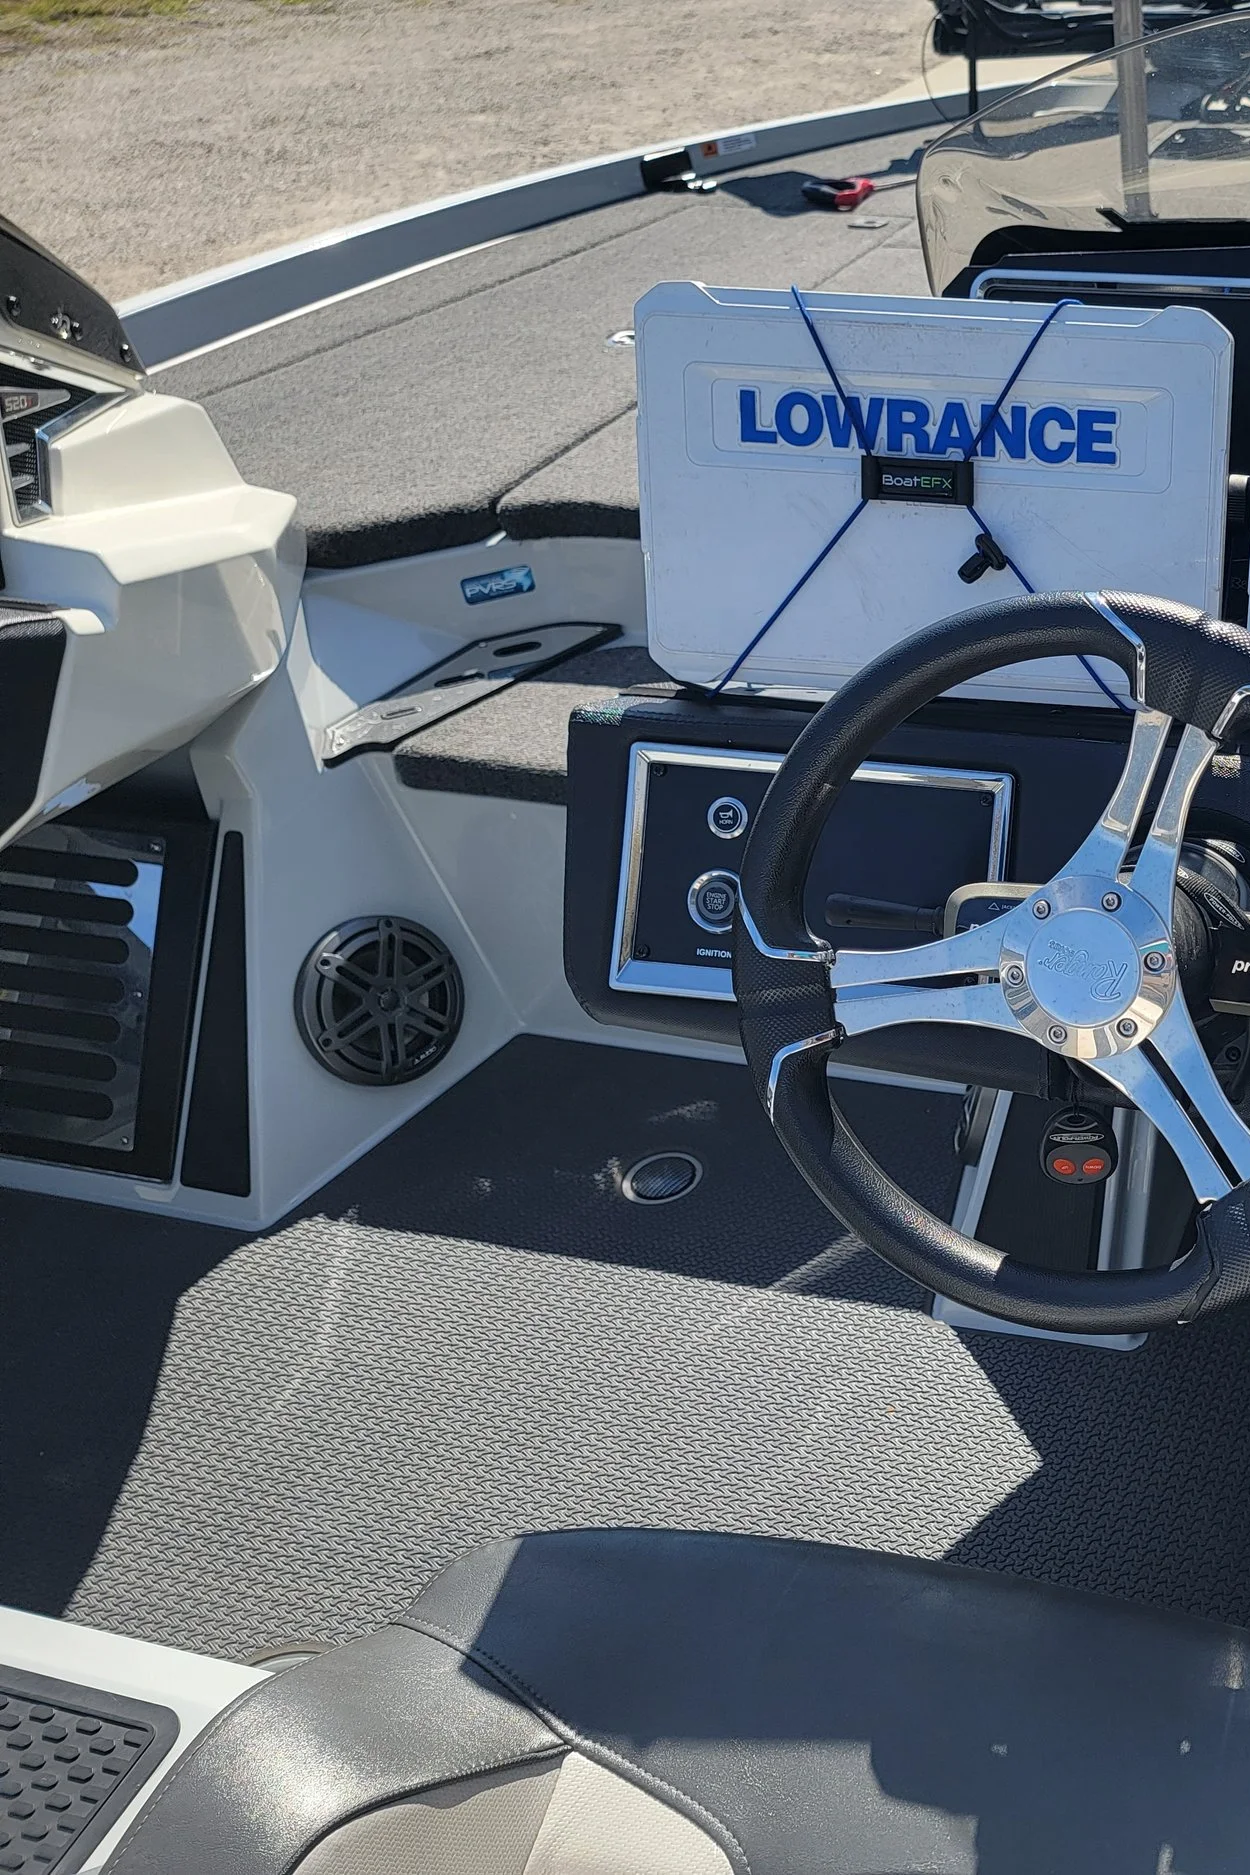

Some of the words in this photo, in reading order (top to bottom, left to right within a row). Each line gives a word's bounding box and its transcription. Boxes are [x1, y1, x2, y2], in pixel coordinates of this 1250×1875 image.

[738, 389, 1117, 465] LOWRANCE
[882, 474, 952, 489] BoatEFX
[706, 891, 727, 899] ENGINE
[706, 897, 726, 905] START
[707, 903, 724, 911] STOP
[696, 947, 732, 959] IGNITION
